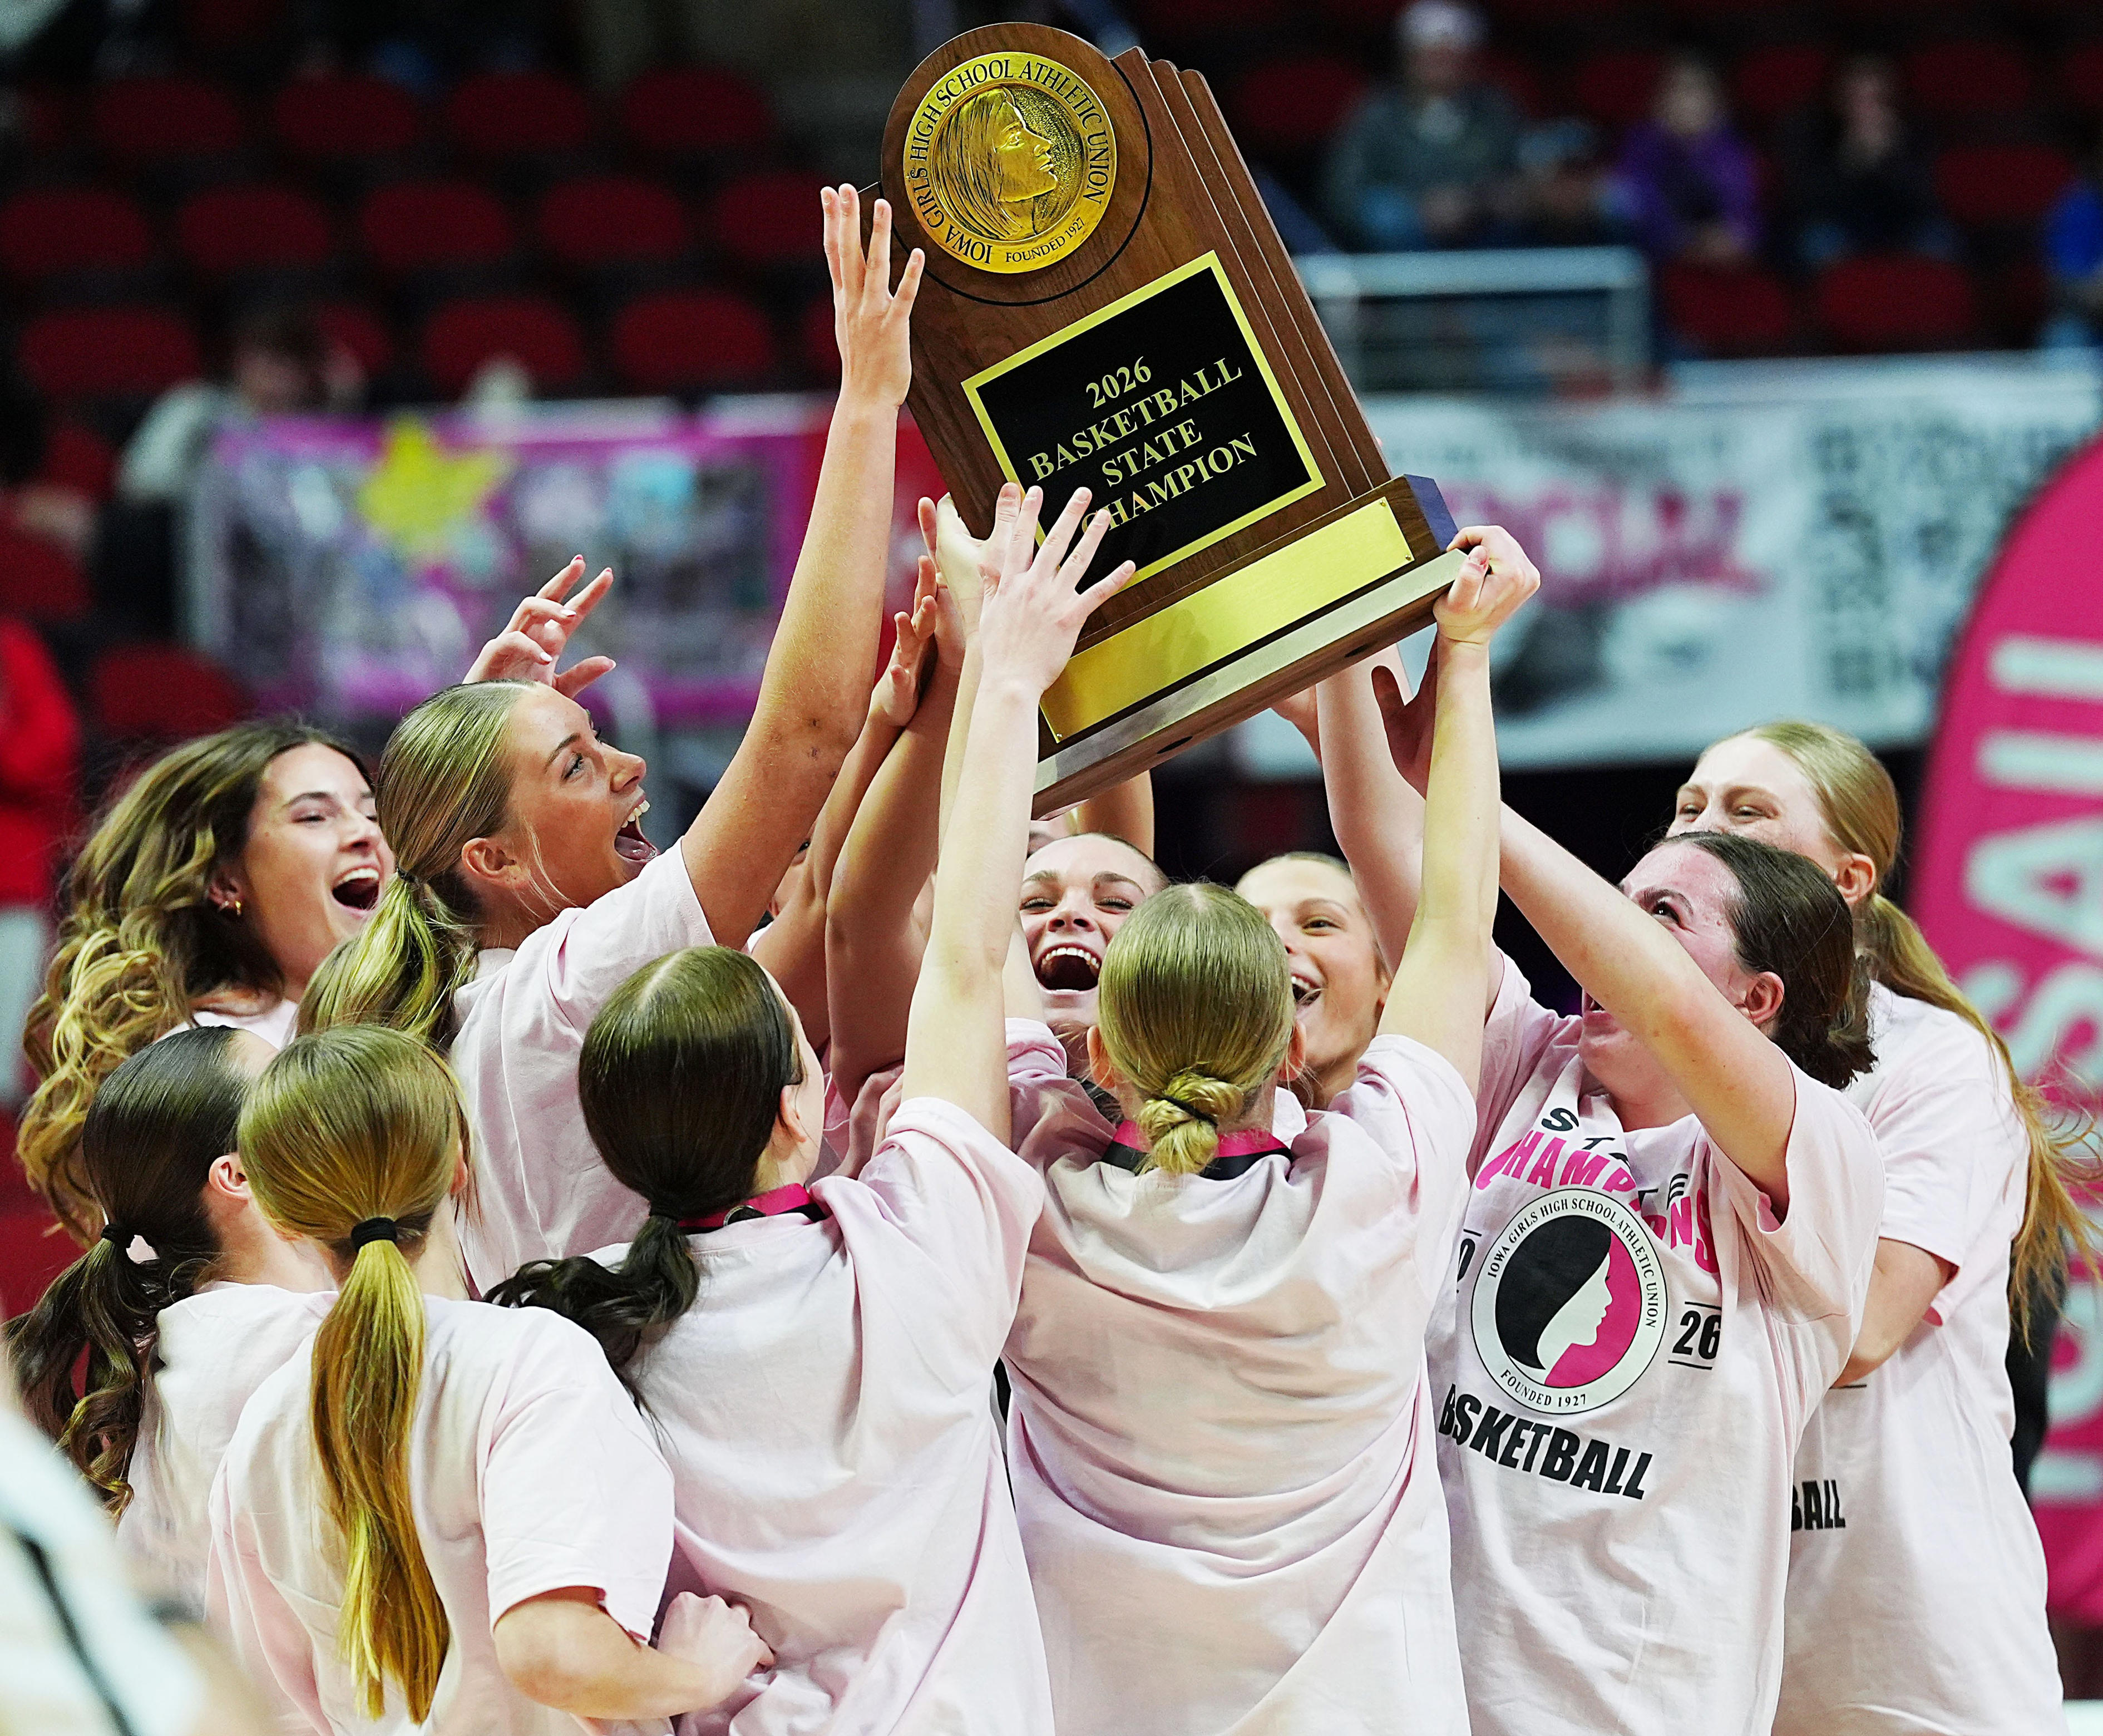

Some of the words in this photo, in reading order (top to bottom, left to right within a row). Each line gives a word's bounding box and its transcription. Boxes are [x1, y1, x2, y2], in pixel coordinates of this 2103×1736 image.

[936, 59, 1014, 107] SCHOOL
[1018, 61, 1102, 129] ATHLETIC
[910, 103, 942, 161] HIGH
[1083, 130, 1109, 205] UNION
[910, 167, 945, 228] GIRLS
[945, 224, 993, 264] IOWA
[1005, 236, 1065, 263] FOUNDED
[1064, 216, 1085, 239] 1927
[1085, 356, 1152, 408] 2026
[1027, 358, 1242, 481] BASKETBALL
[1102, 417, 1202, 487] STATE
[1488, 1246, 1510, 1278] IOWA
[1508, 1211, 1538, 1244] GIRLS
[1539, 1199, 1568, 1217] HIGH
[1572, 1198, 1616, 1223] SCHOOL
[1616, 1220, 1655, 1279] ATHLETIC
[1645, 1282, 1658, 1328] UNION
[1672, 1310, 1722, 1359] 26
[1500, 1369, 1552, 1406] FOUNDED
[1558, 1394, 1587, 1408] 1927
